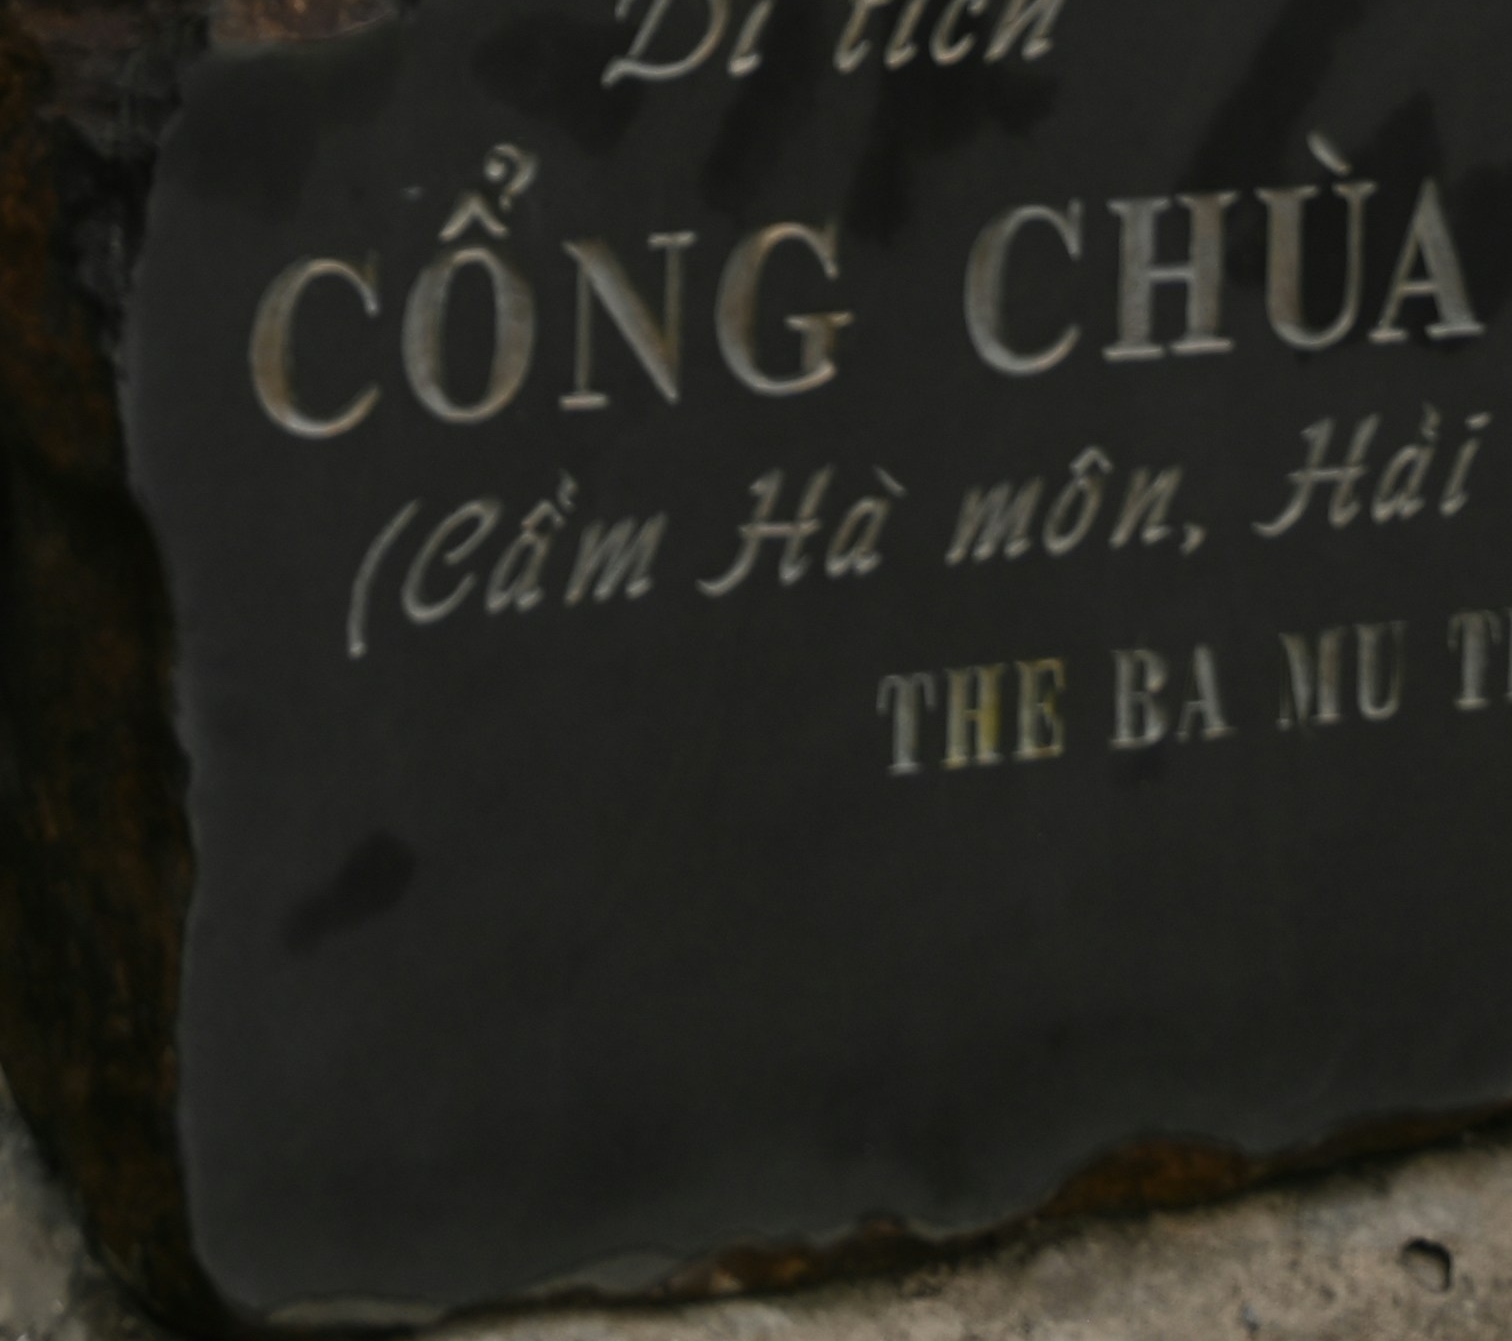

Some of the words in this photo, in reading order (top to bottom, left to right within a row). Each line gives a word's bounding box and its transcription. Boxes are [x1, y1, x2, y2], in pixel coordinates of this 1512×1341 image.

[246, 142, 853, 440] CỔNG
[962, 132, 1487, 378] CHÙA
[695, 463, 908, 598] Hà
[944, 445, 1206, 566] môn,
[1251, 400, 1494, 538] Hải
[877, 655, 1067, 777] THE
[1109, 643, 1238, 751] BA
[1276, 619, 1409, 734] MU
